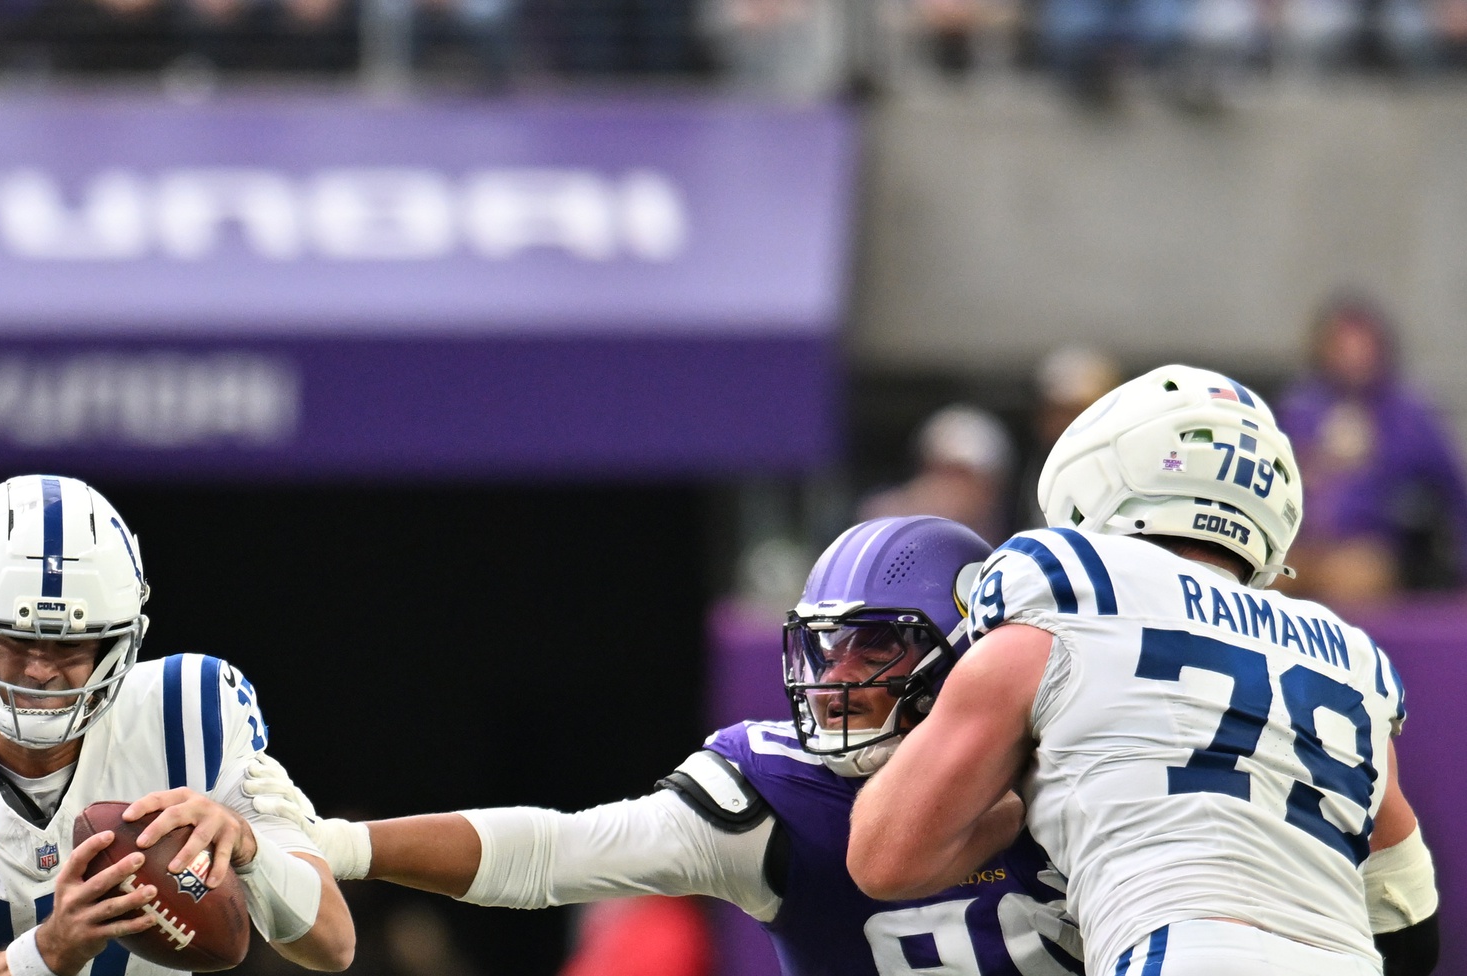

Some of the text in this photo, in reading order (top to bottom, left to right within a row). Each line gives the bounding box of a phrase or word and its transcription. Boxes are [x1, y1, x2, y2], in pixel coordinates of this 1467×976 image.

[1193, 513, 1251, 546] COLTS
[37, 602, 66, 611] COLTS
[1177, 574, 1351, 671] RAIMANN
[1134, 627, 1379, 870] 79
